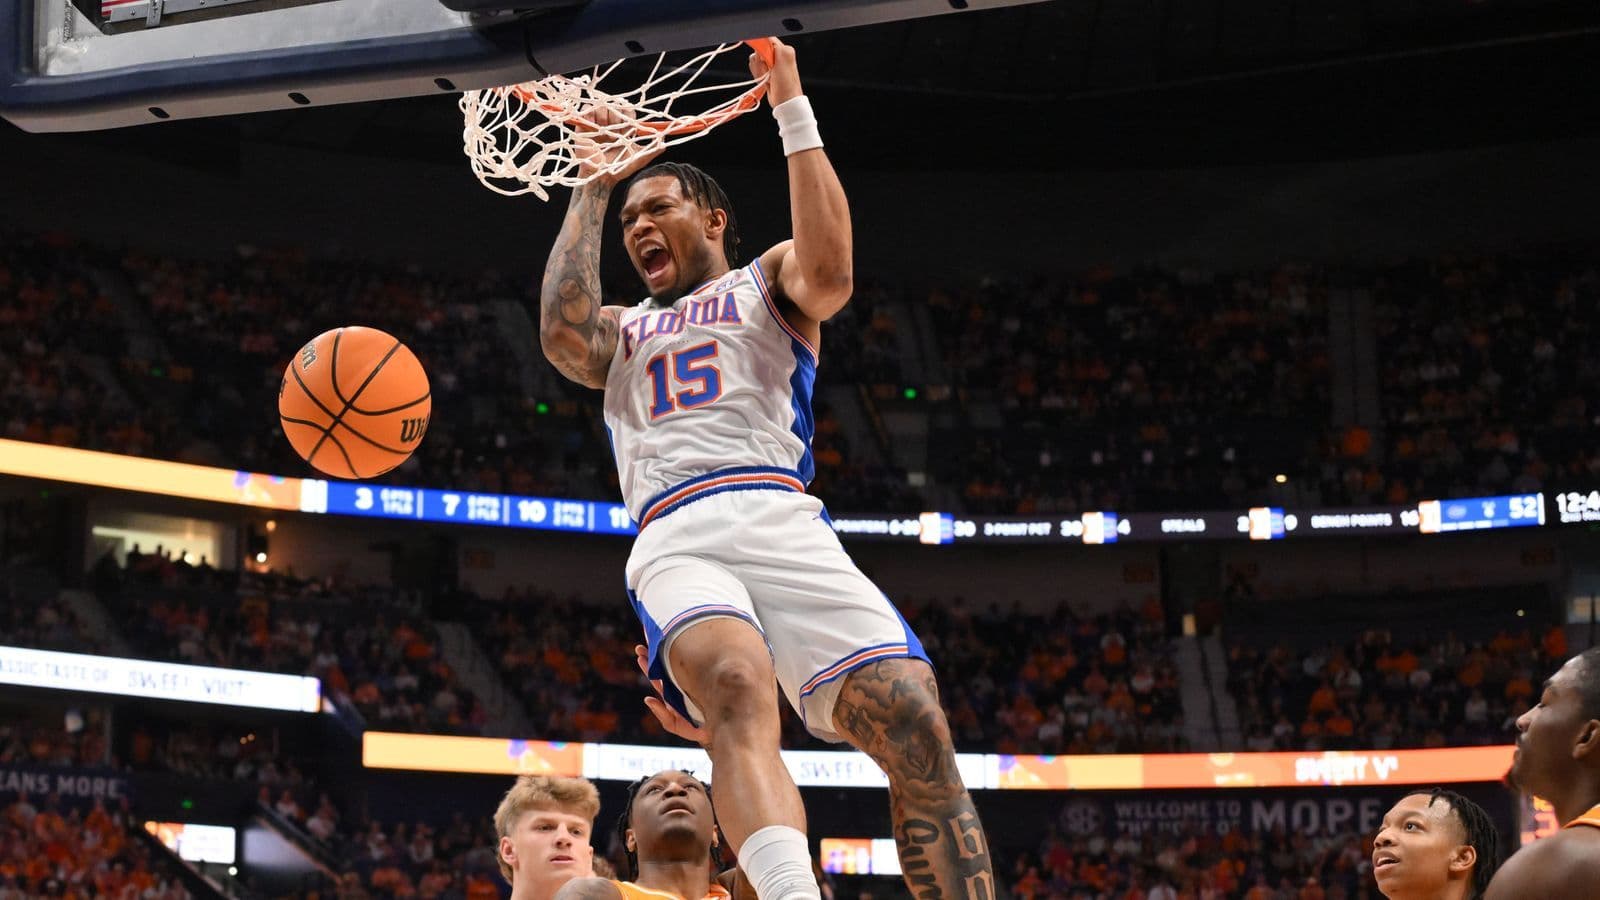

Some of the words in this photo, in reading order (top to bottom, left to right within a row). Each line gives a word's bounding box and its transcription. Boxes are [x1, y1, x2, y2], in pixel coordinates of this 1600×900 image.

[646, 339, 722, 420] 15
[355, 487, 374, 510] 3
[442, 494, 461, 516] 7
[1509, 496, 1538, 519] 52
[517, 500, 547, 523] 10
